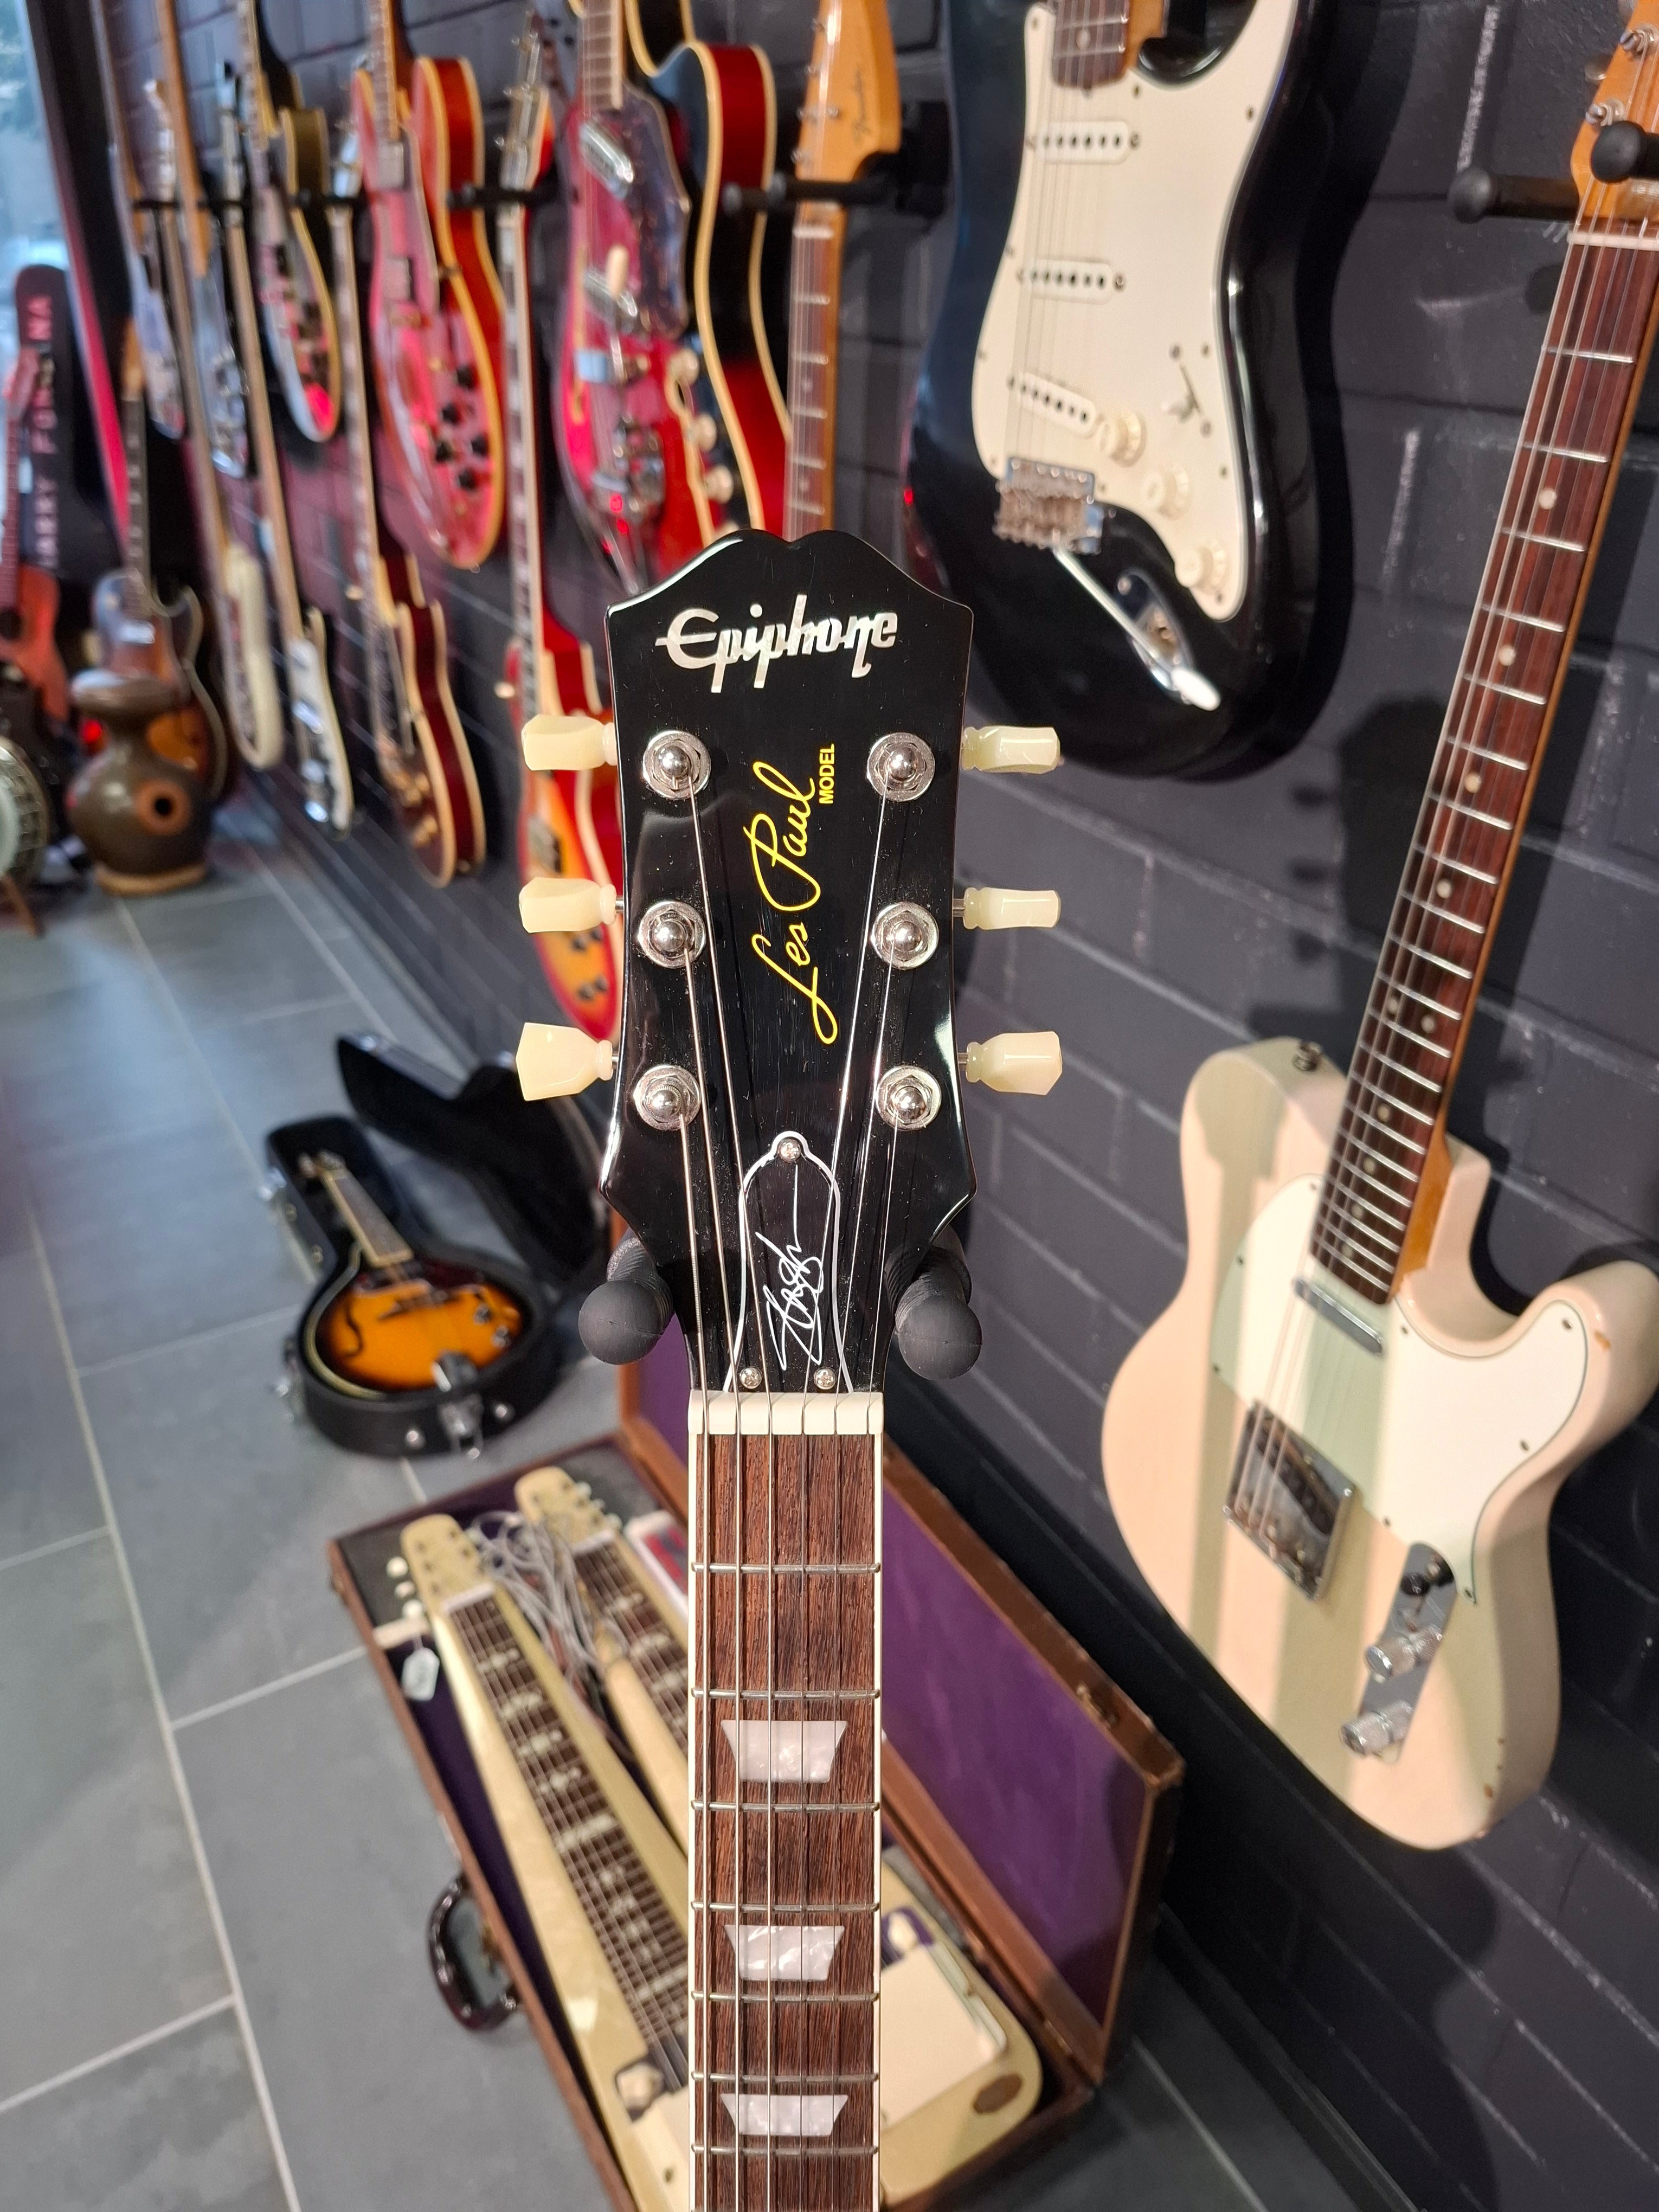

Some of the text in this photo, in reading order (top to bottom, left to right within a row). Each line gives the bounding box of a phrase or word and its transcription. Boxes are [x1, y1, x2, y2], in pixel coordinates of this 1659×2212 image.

[654, 594, 898, 693] Epiphone
[819, 743, 835, 804] MODEL
[743, 761, 838, 1045] Les Paul
